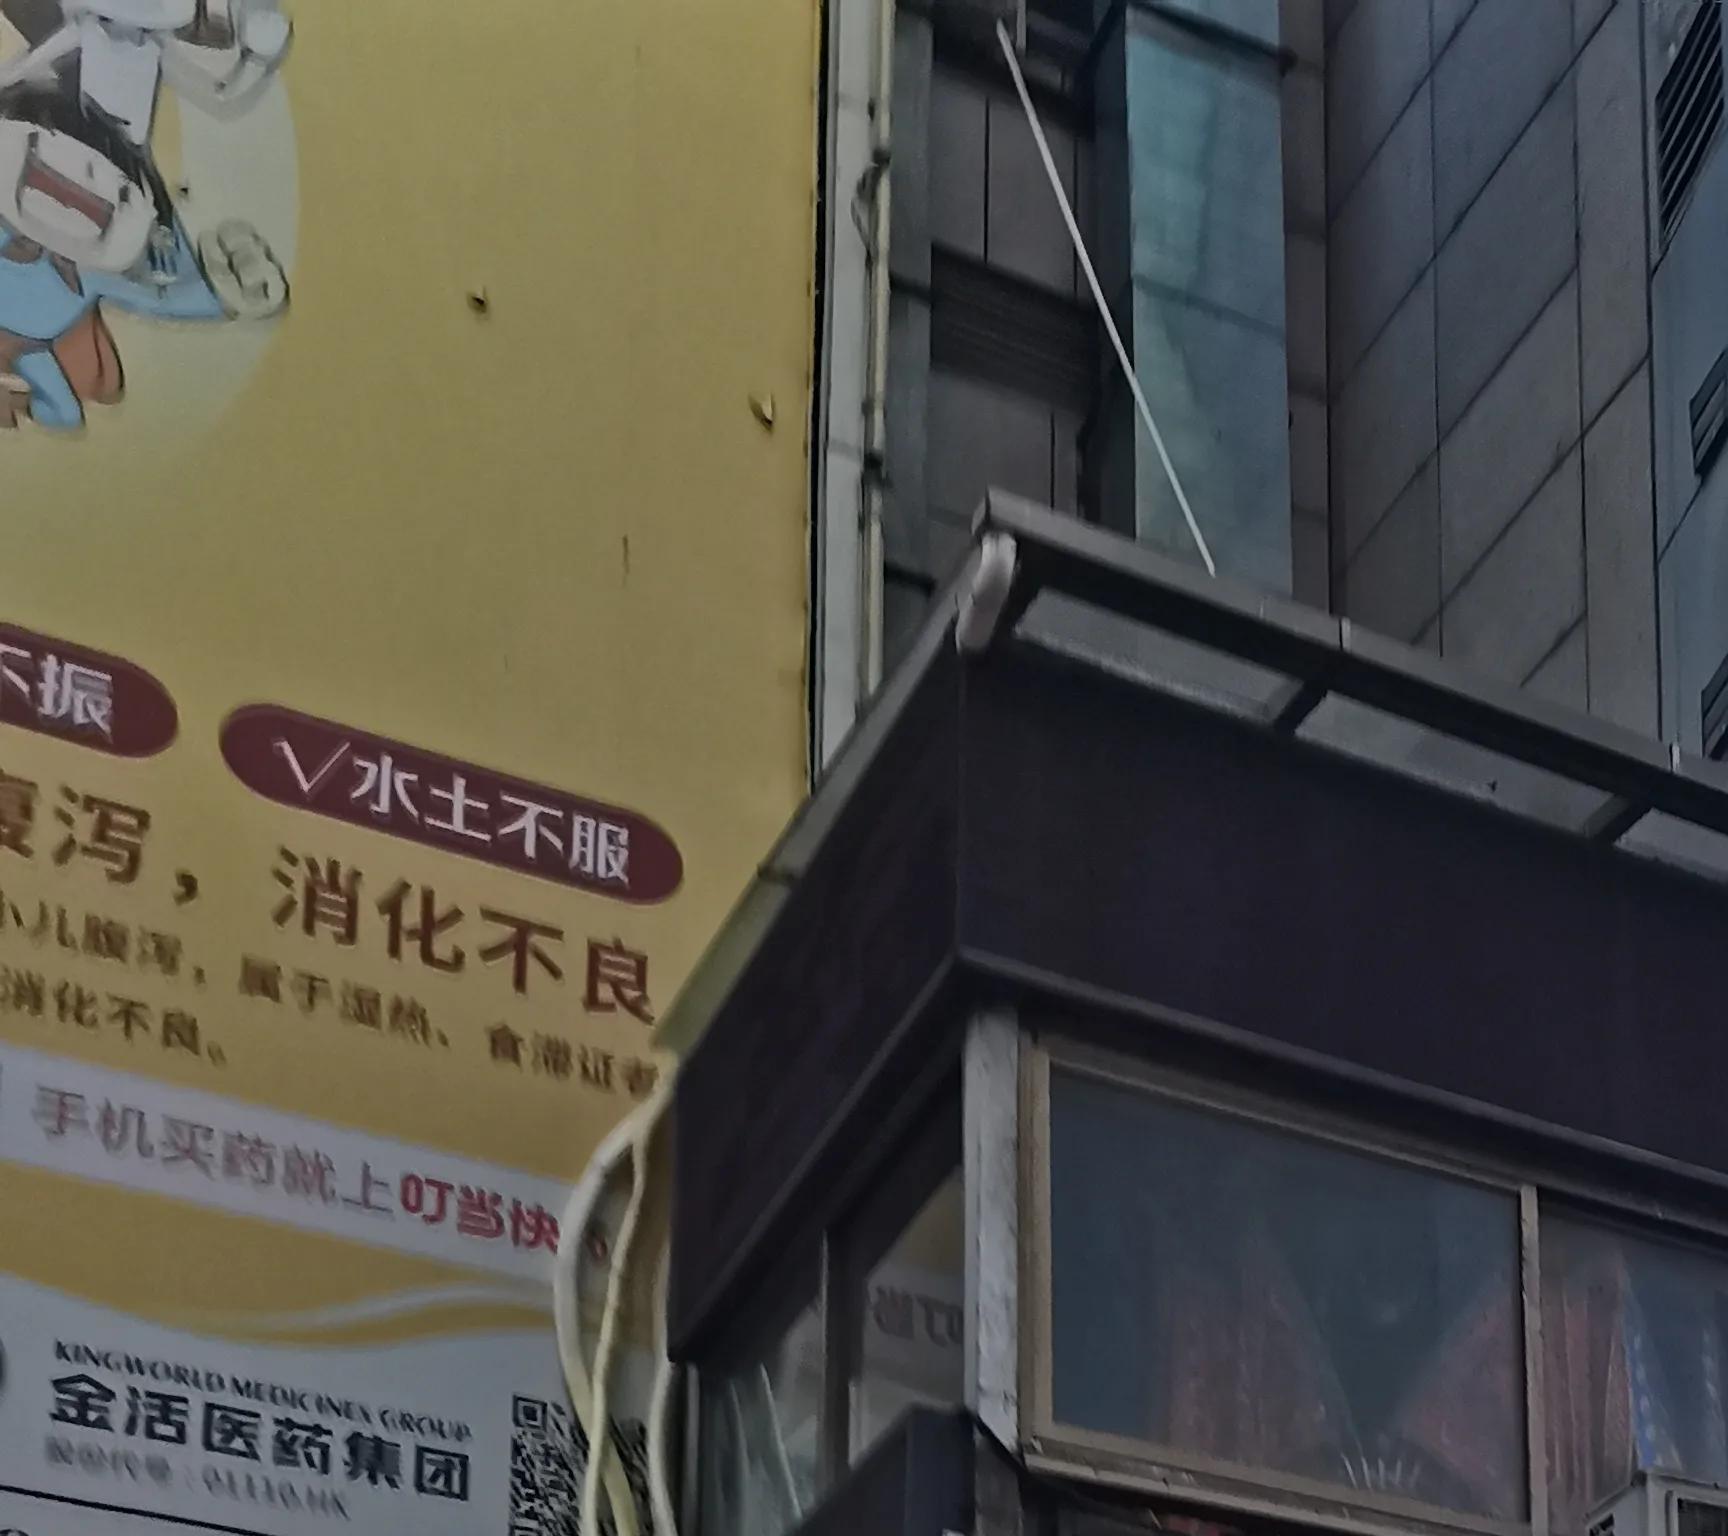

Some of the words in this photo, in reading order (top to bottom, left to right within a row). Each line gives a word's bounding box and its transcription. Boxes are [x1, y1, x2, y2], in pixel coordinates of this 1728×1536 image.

[33, 1084, 608, 1264] 手机买药就上叮当快
[48, 1372, 471, 1501] 金活医药集团
